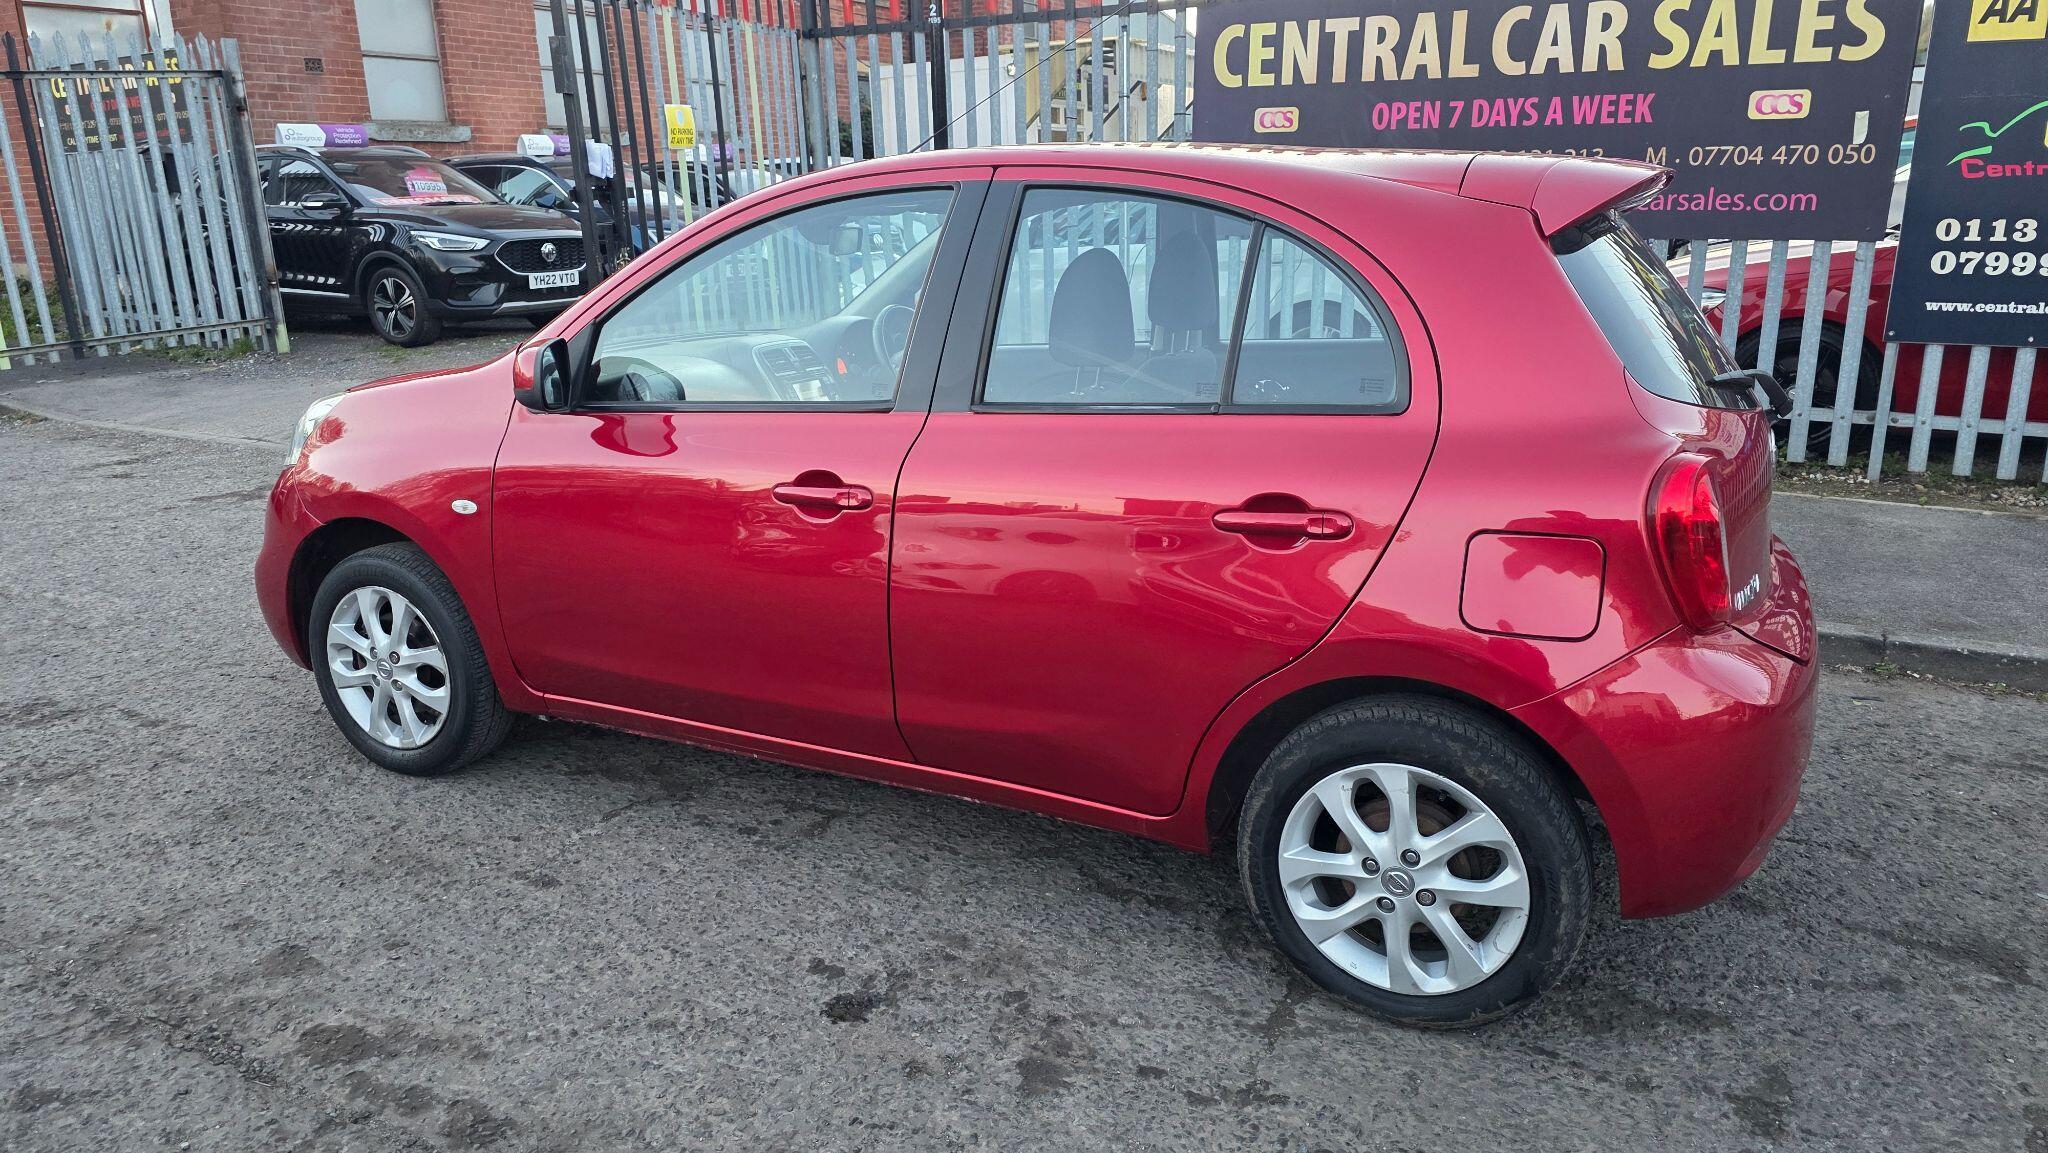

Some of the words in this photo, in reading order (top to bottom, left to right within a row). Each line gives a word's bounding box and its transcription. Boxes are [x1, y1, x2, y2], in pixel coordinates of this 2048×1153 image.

[930, 4, 937, 16] 2
[1978, 0, 2038, 24] AA
[1213, 10, 1479, 88] CENTRAL
[1492, 1, 1628, 76] CAR
[1648, 0, 1886, 69] SALES
[1372, 101, 1441, 130] OPEN
[1449, 101, 1464, 128] 7
[1471, 97, 1539, 128] DAYS
[1544, 97, 1563, 126] A
[1573, 93, 1656, 125] WEEK
[1688, 146, 1764, 166] 07704
[1772, 145, 1820, 165] 470
[1827, 143, 1876, 165] 050
[1637, 186, 1817, 212] arsales.com
[1936, 218, 2038, 242] 0113
[533, 274, 557, 286] YH22
[559, 272, 576, 283] VTO
